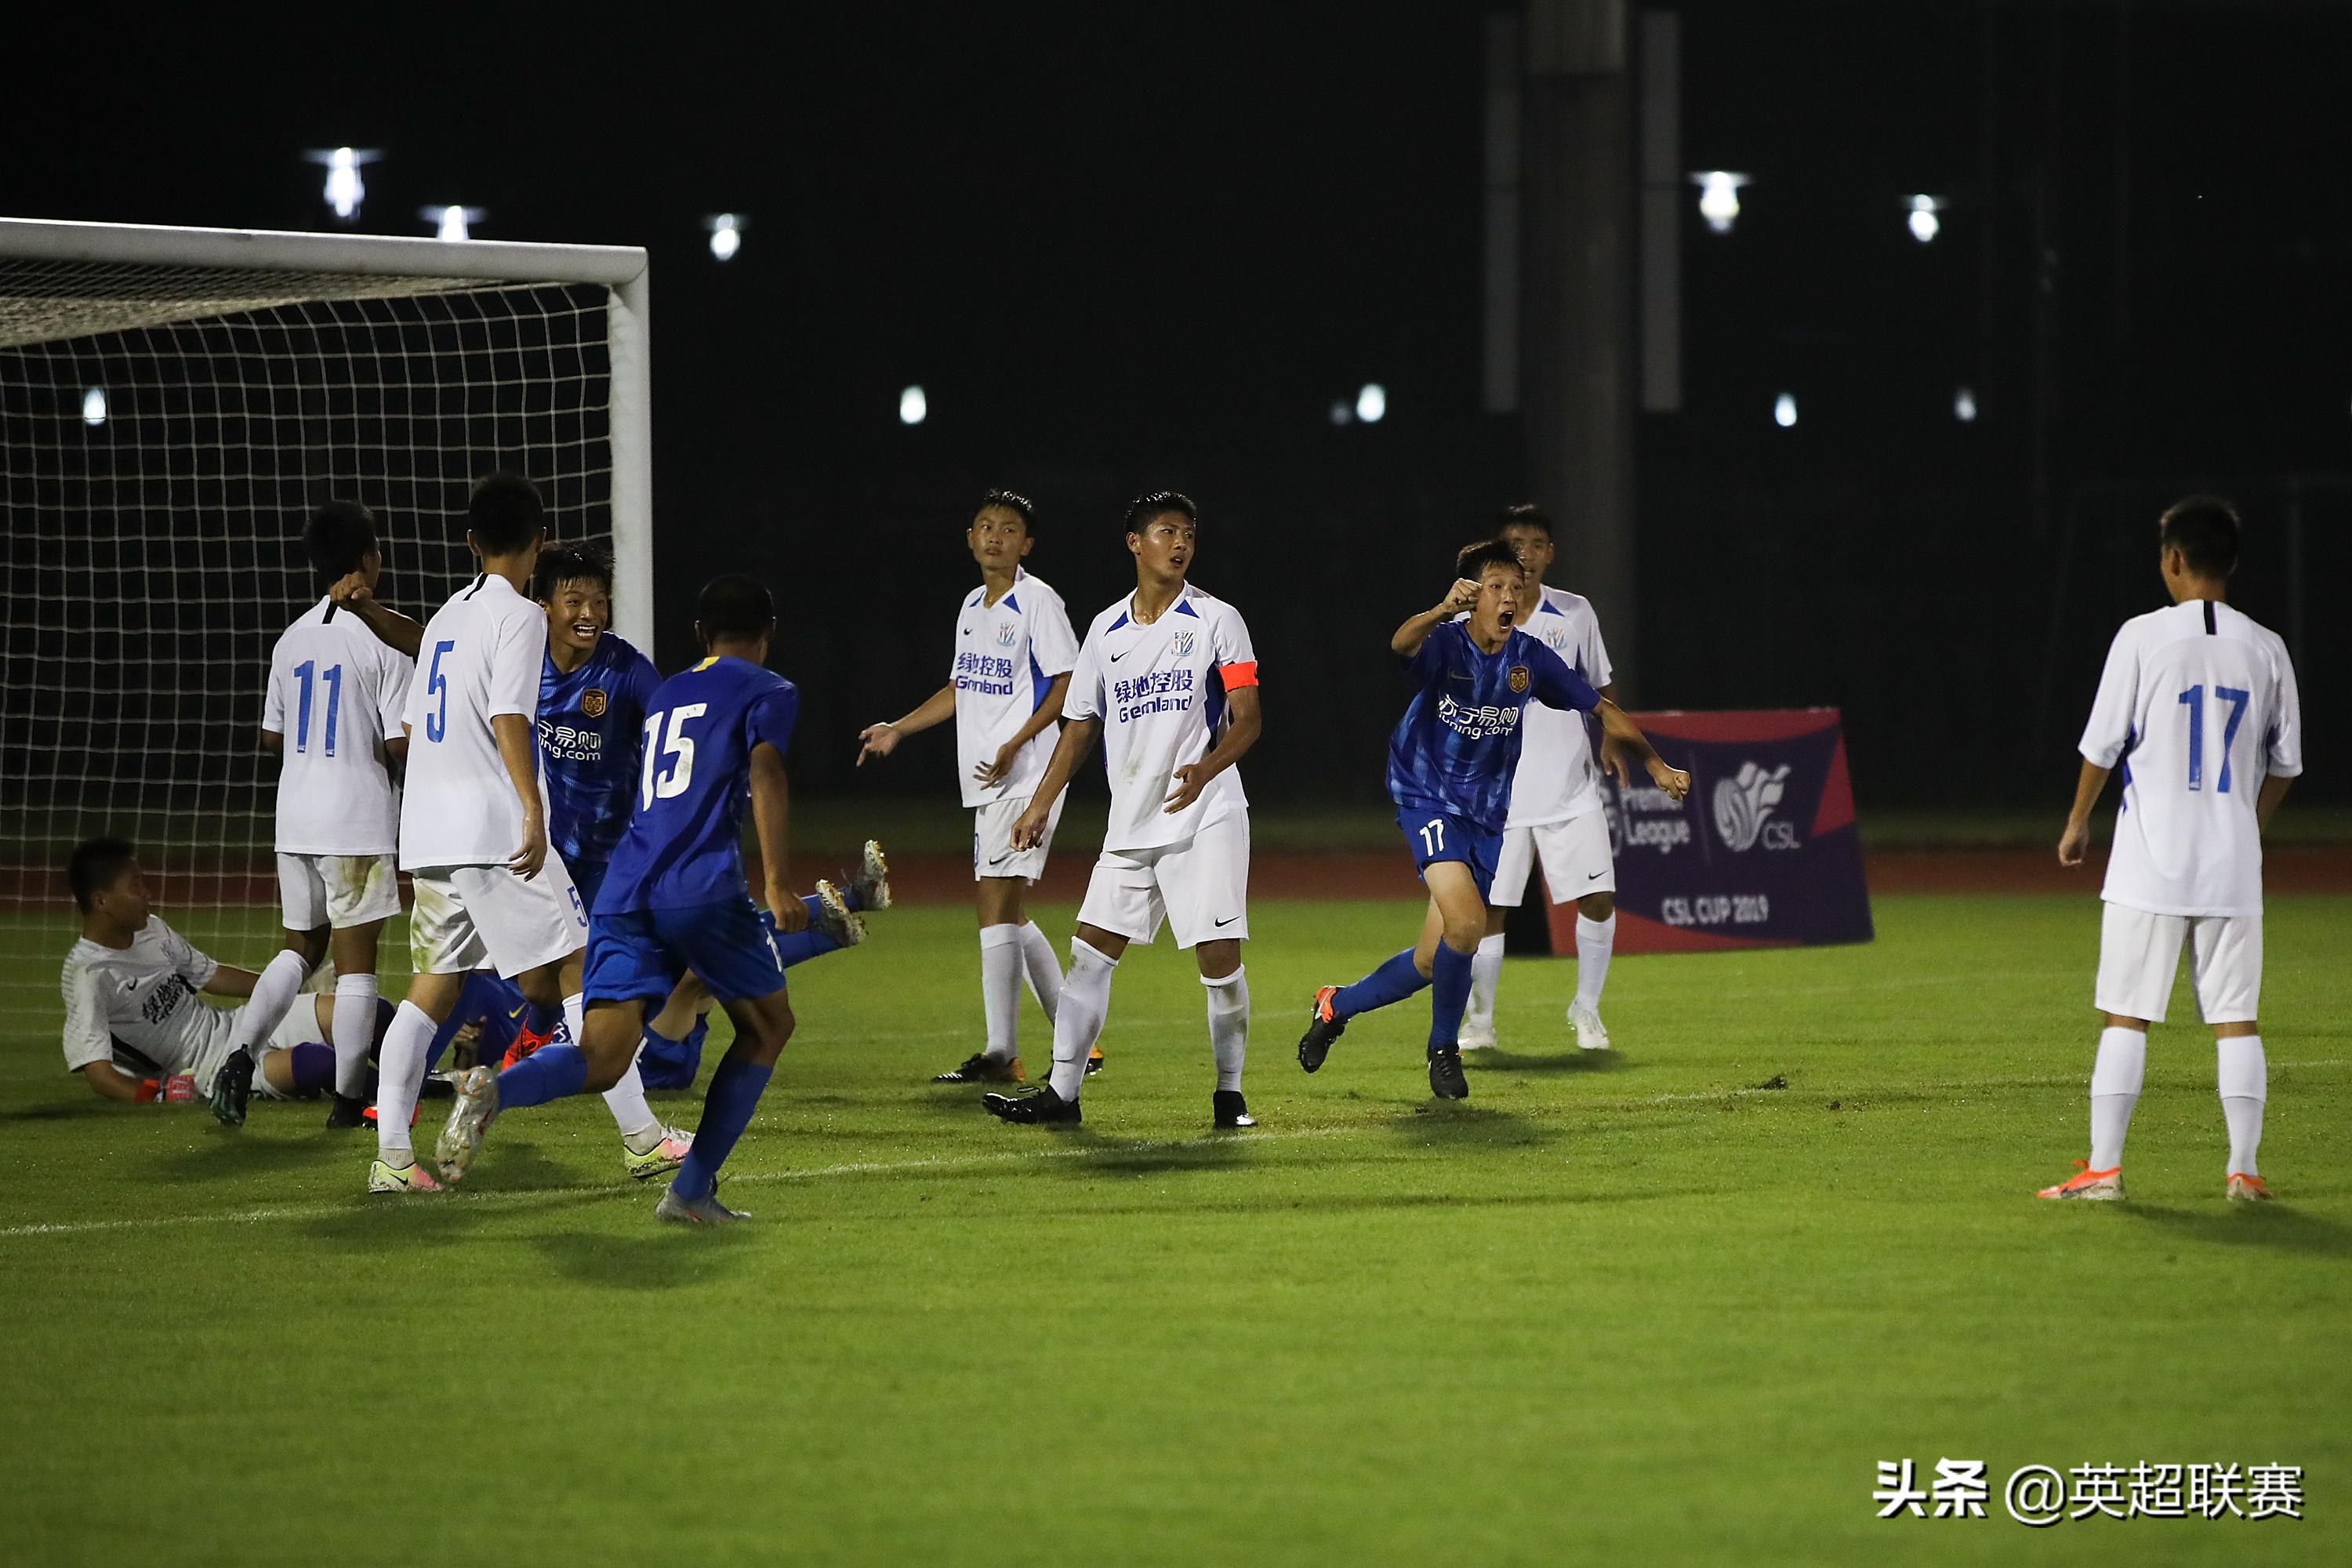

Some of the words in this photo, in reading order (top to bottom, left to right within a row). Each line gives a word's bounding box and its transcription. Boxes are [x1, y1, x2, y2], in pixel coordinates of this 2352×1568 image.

[426, 640, 455, 743] 5
[1114, 669, 1194, 704] 绿地控股
[294, 660, 342, 757] 11
[1439, 694, 1519, 727] 苏宁易购
[1439, 711, 1512, 739] uning.com
[538, 720, 601, 750] 宁易购
[539, 735, 601, 760] ing.com
[2179, 684, 2250, 793] 17
[642, 702, 707, 812] 15
[1419, 818, 1444, 857] 17
[1624, 815, 1690, 854] League
[1762, 822, 1802, 850] CSL
[567, 885, 588, 928] 5
[1661, 897, 1695, 925] CSL
[1695, 895, 1731, 924] CUP
[1732, 894, 1769, 924] 2019
